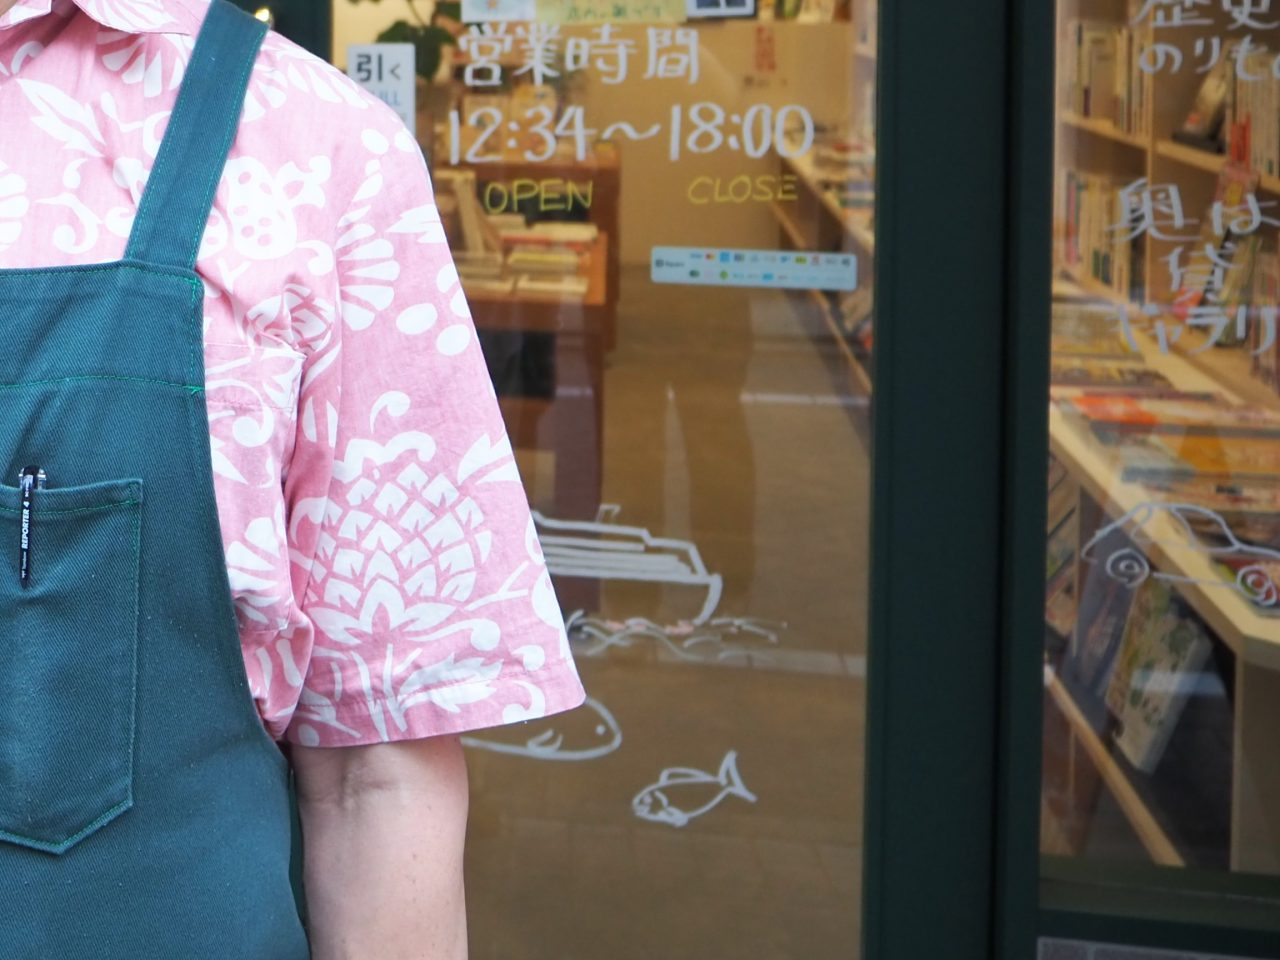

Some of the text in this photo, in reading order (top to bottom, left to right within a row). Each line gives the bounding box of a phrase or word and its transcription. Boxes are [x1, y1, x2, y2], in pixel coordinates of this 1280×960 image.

[356, 52, 402, 83] 引く
[458, 23, 700, 87] 営業時間
[1138, 35, 1280, 81] のりも
[484, 178, 594, 213] OPEN
[687, 176, 799, 205] CLOSE
[21, 509, 30, 550] REPORTER
